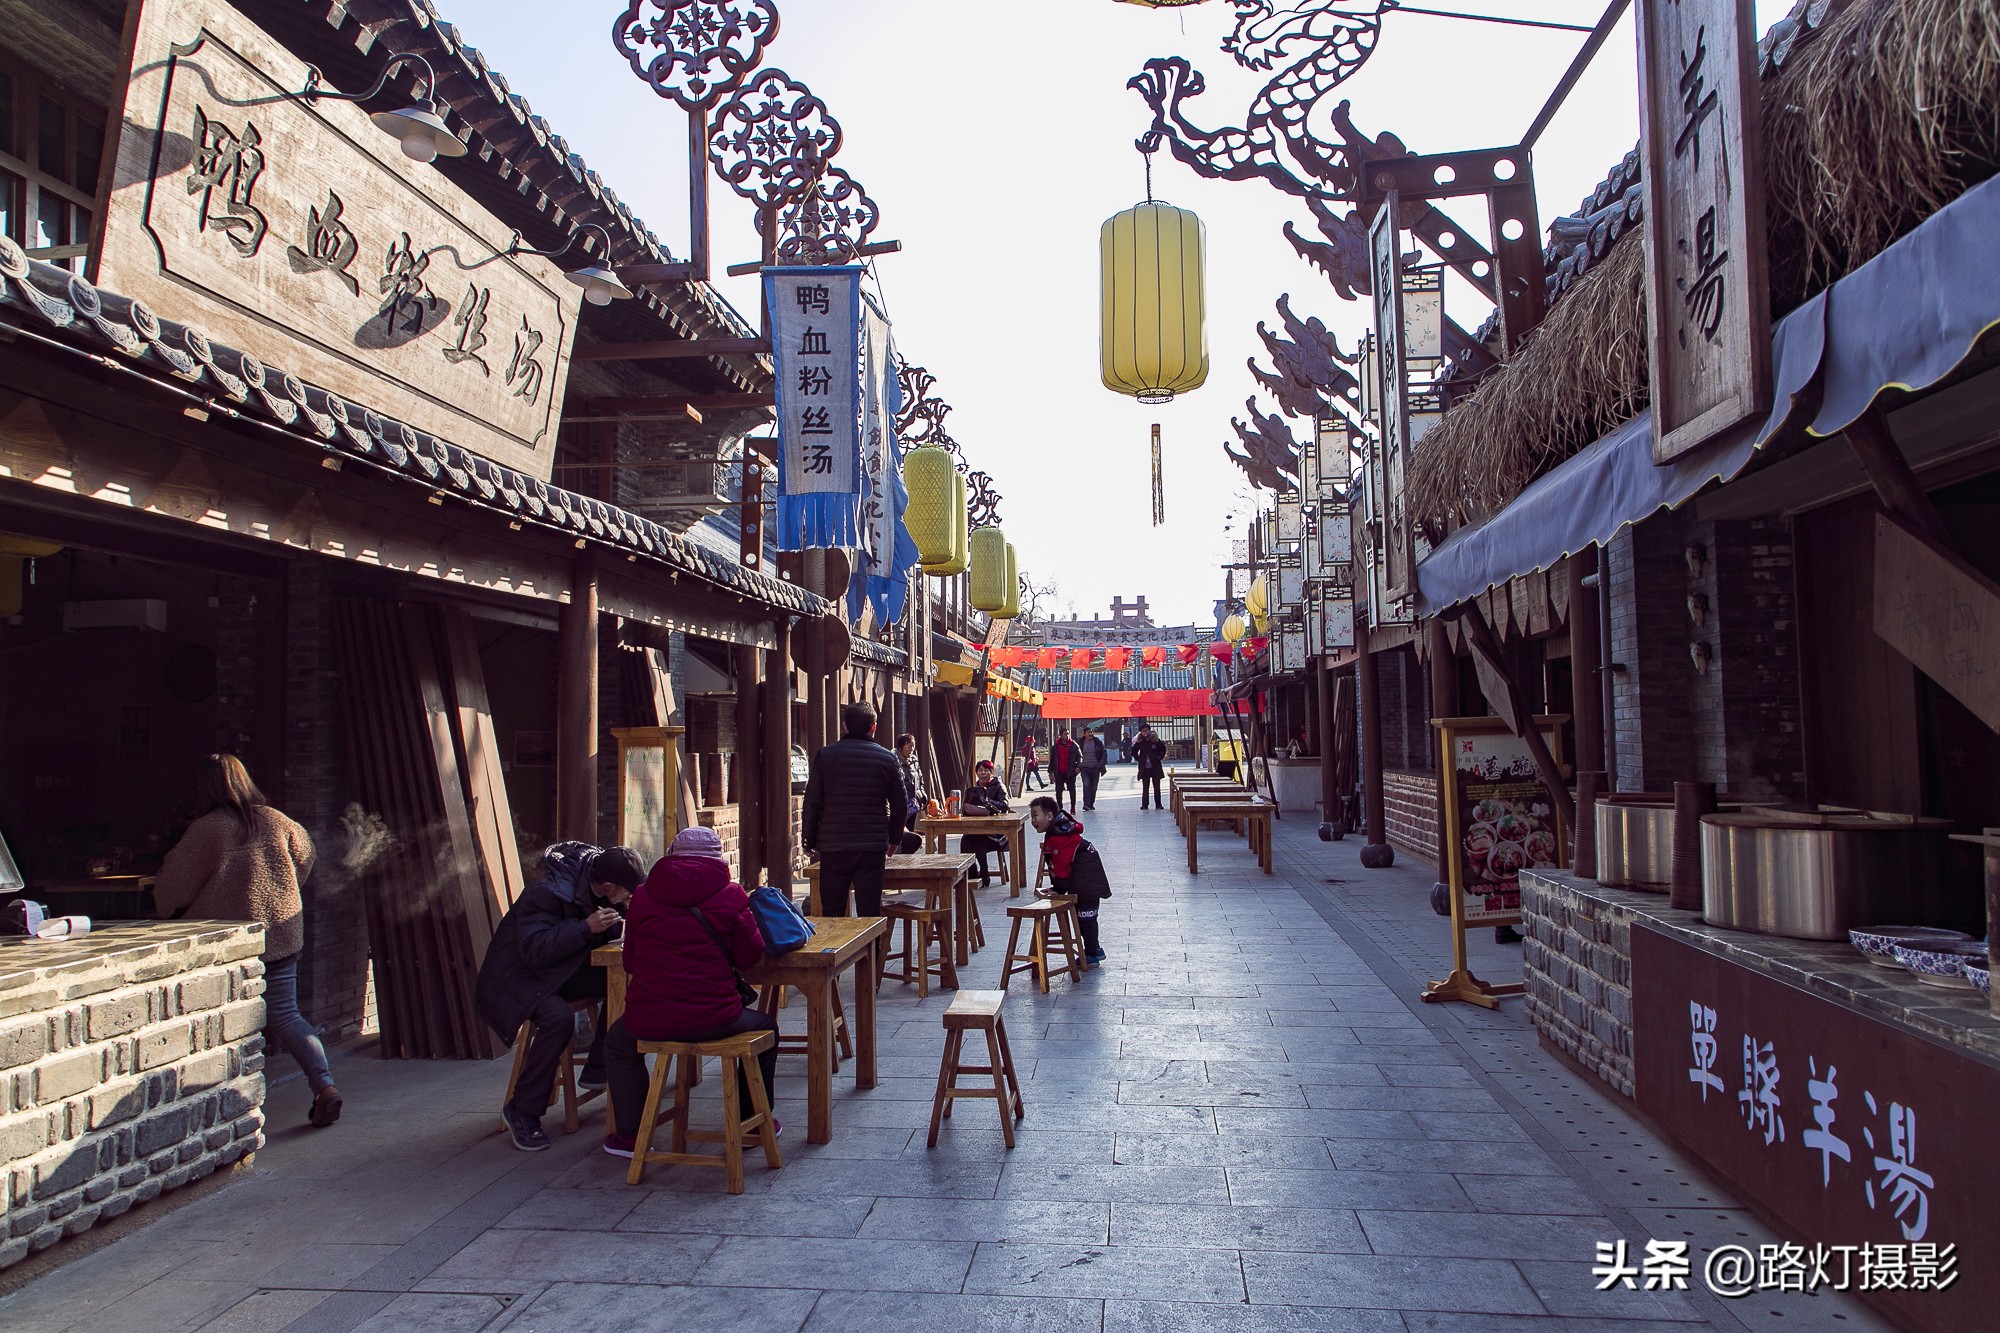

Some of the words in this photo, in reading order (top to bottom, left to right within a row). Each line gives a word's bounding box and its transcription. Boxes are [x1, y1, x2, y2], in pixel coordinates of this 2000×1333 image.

[1668, 0, 1728, 350] 羊湯
[796, 283, 834, 475] 鸭血粉丝汤
[1688, 1000, 1934, 1241] 單縣羊湯
